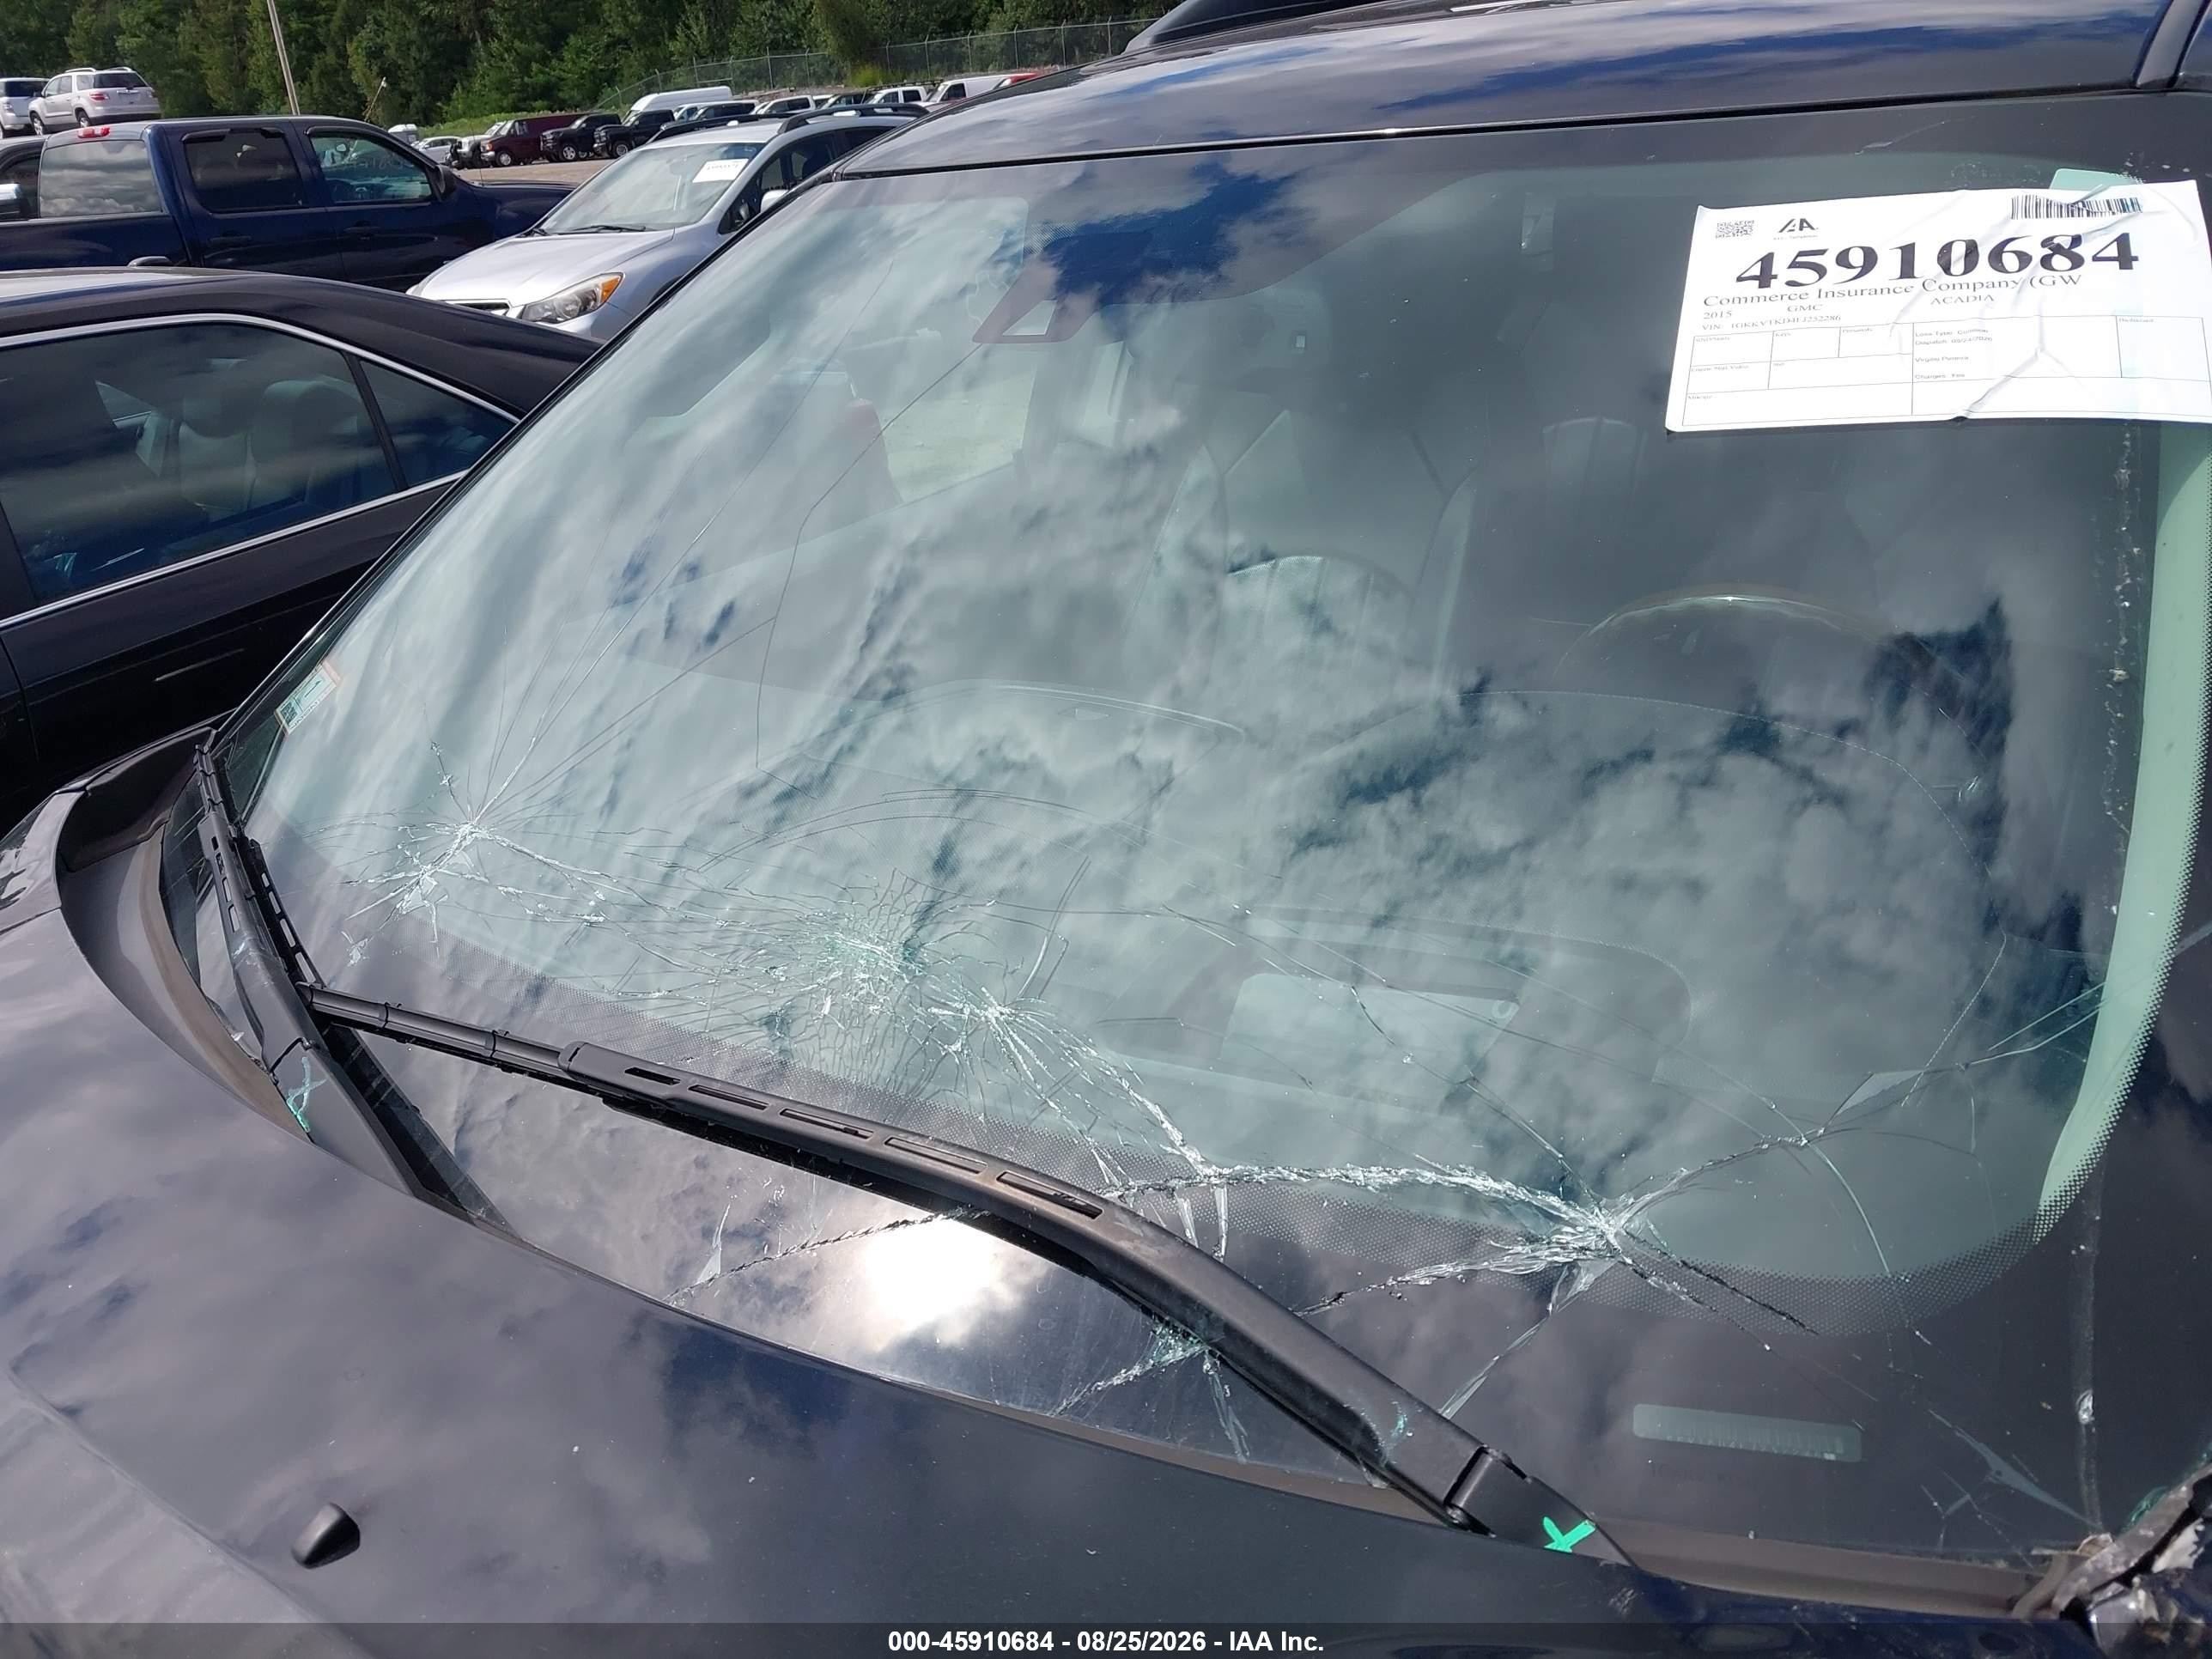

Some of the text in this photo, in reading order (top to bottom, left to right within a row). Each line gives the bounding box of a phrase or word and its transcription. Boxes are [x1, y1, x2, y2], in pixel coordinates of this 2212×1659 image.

[1735, 233, 2138, 289] 45910684
[1703, 295, 1995, 319] 2015 GMC ACADIA
[1704, 274, 2081, 307] Commerce Insurance Company (GW
